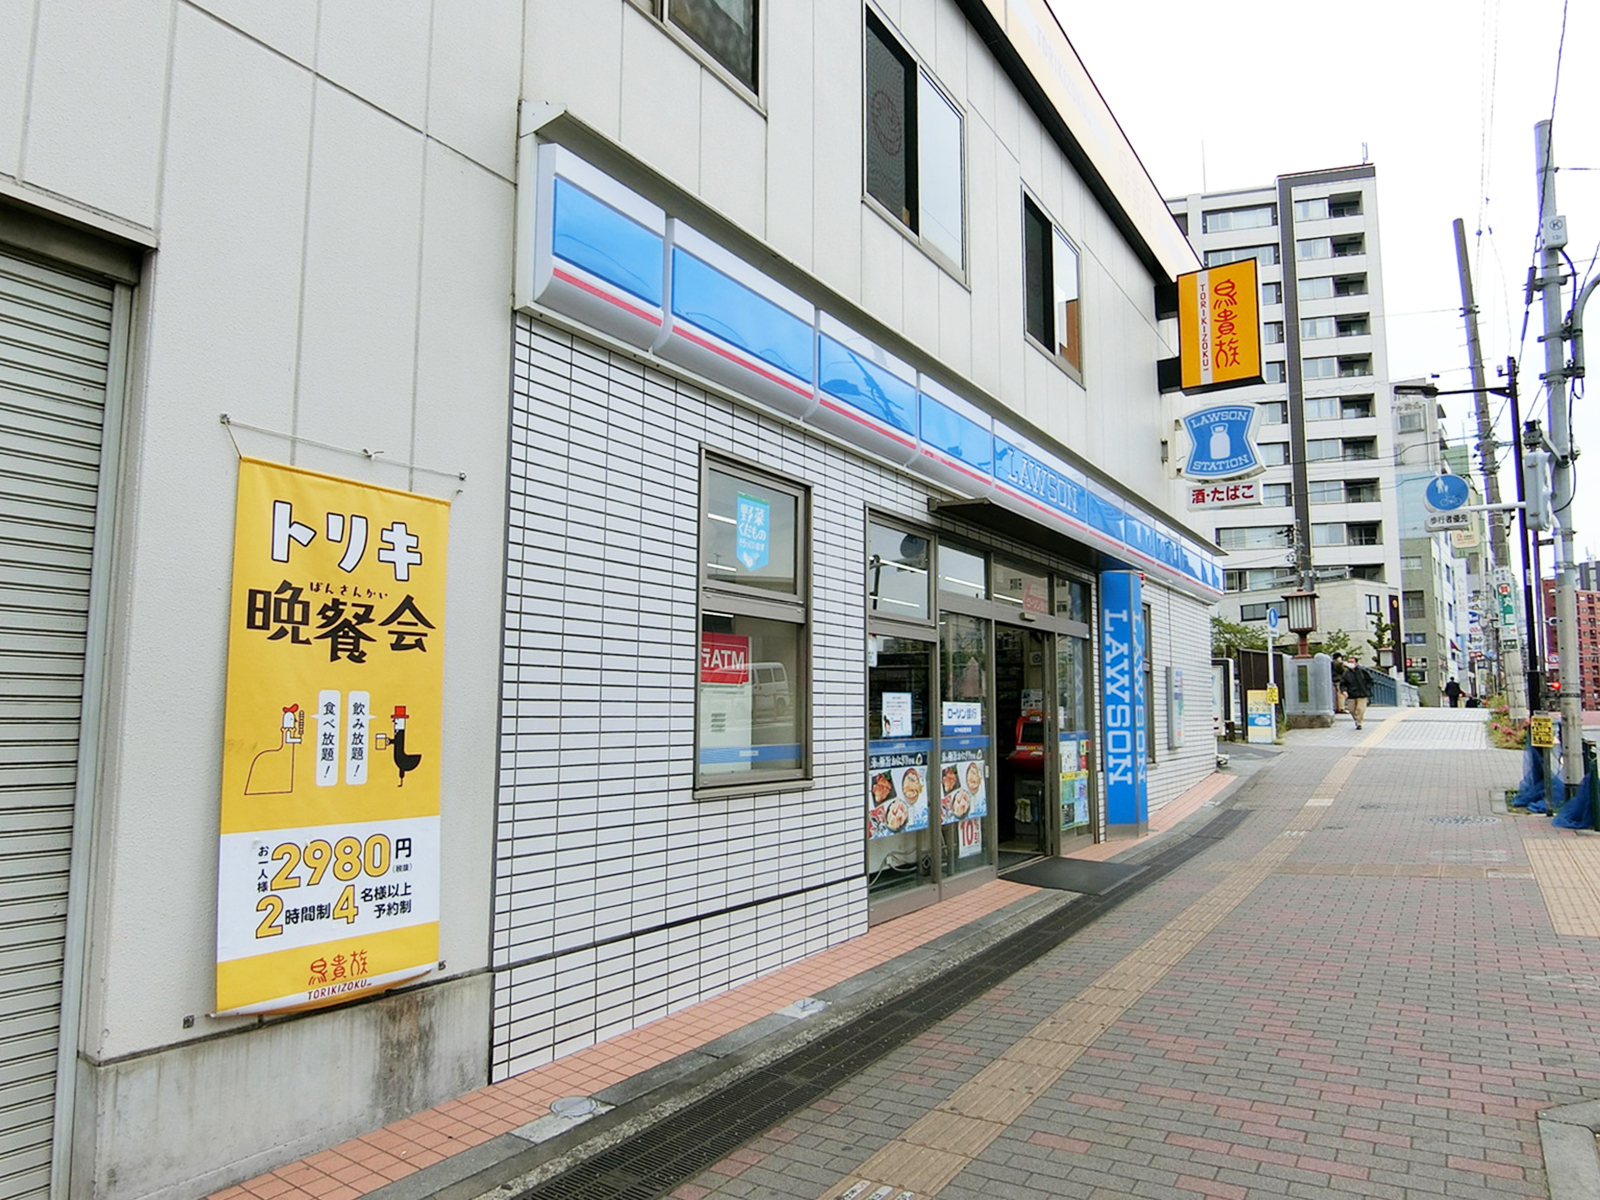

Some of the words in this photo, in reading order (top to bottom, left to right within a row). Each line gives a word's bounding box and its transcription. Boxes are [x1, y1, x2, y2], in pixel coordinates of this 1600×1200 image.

[1191, 411, 1248, 429] LAWSON
[1007, 446, 1078, 514] LAWSON
[1193, 454, 1249, 471] STATION
[272, 500, 422, 581] トリキ
[1430, 514, 1468, 525] 歩行者優先
[310, 582, 388, 599] ばんさんかい
[247, 580, 436, 664] 晩餐会
[1104, 609, 1132, 785] LAWSON
[1132, 612, 1146, 784] LAWSON
[257, 846, 269, 892] お一人様
[374, 899, 411, 918] 予約制
